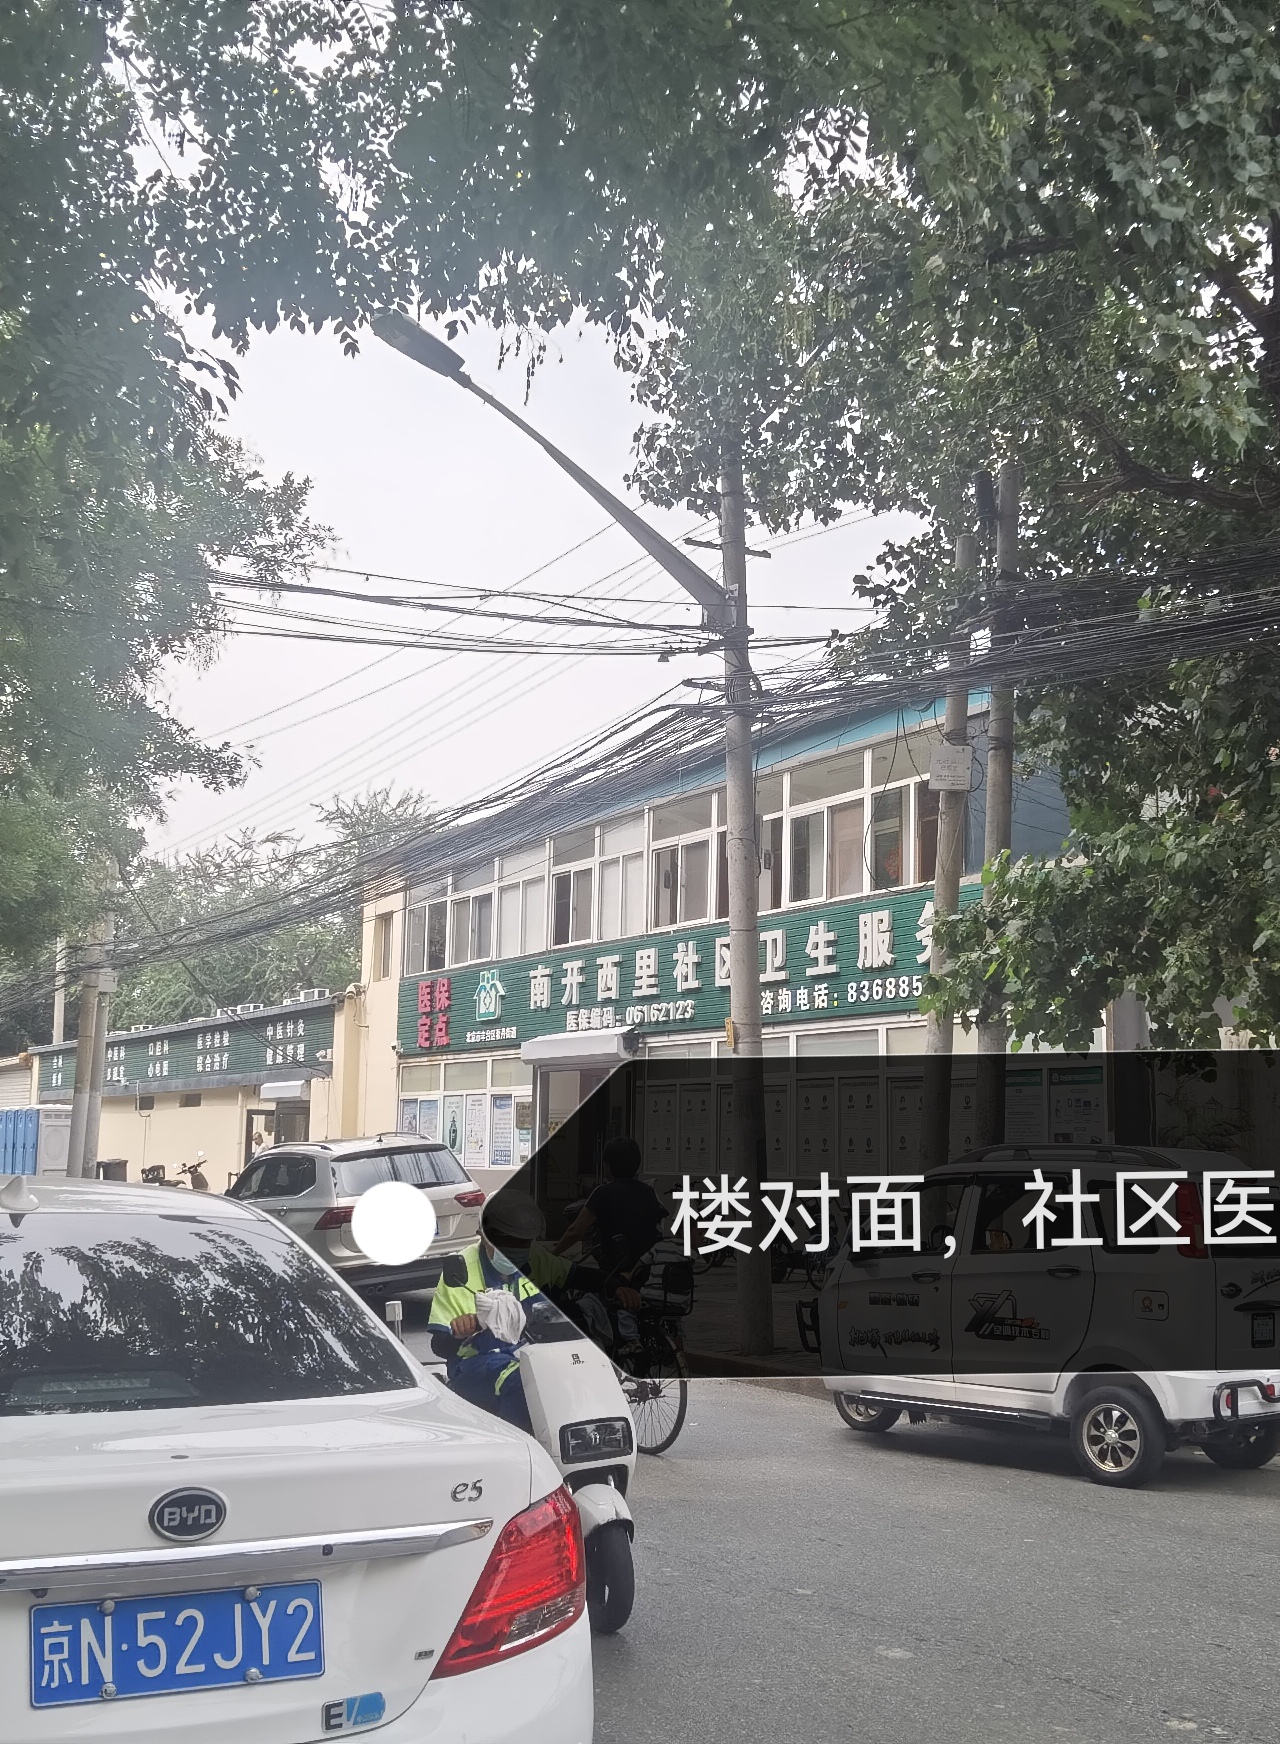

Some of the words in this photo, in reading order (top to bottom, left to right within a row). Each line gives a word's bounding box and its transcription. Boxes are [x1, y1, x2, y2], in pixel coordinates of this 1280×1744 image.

[418, 978, 451, 1013] 医保
[266, 1019, 304, 1041] 中医针灸
[417, 1014, 450, 1048] 定点
[266, 1043, 304, 1066] 健康管理
[450, 1478, 483, 1502] e5
[163, 1504, 217, 1527] BYD
